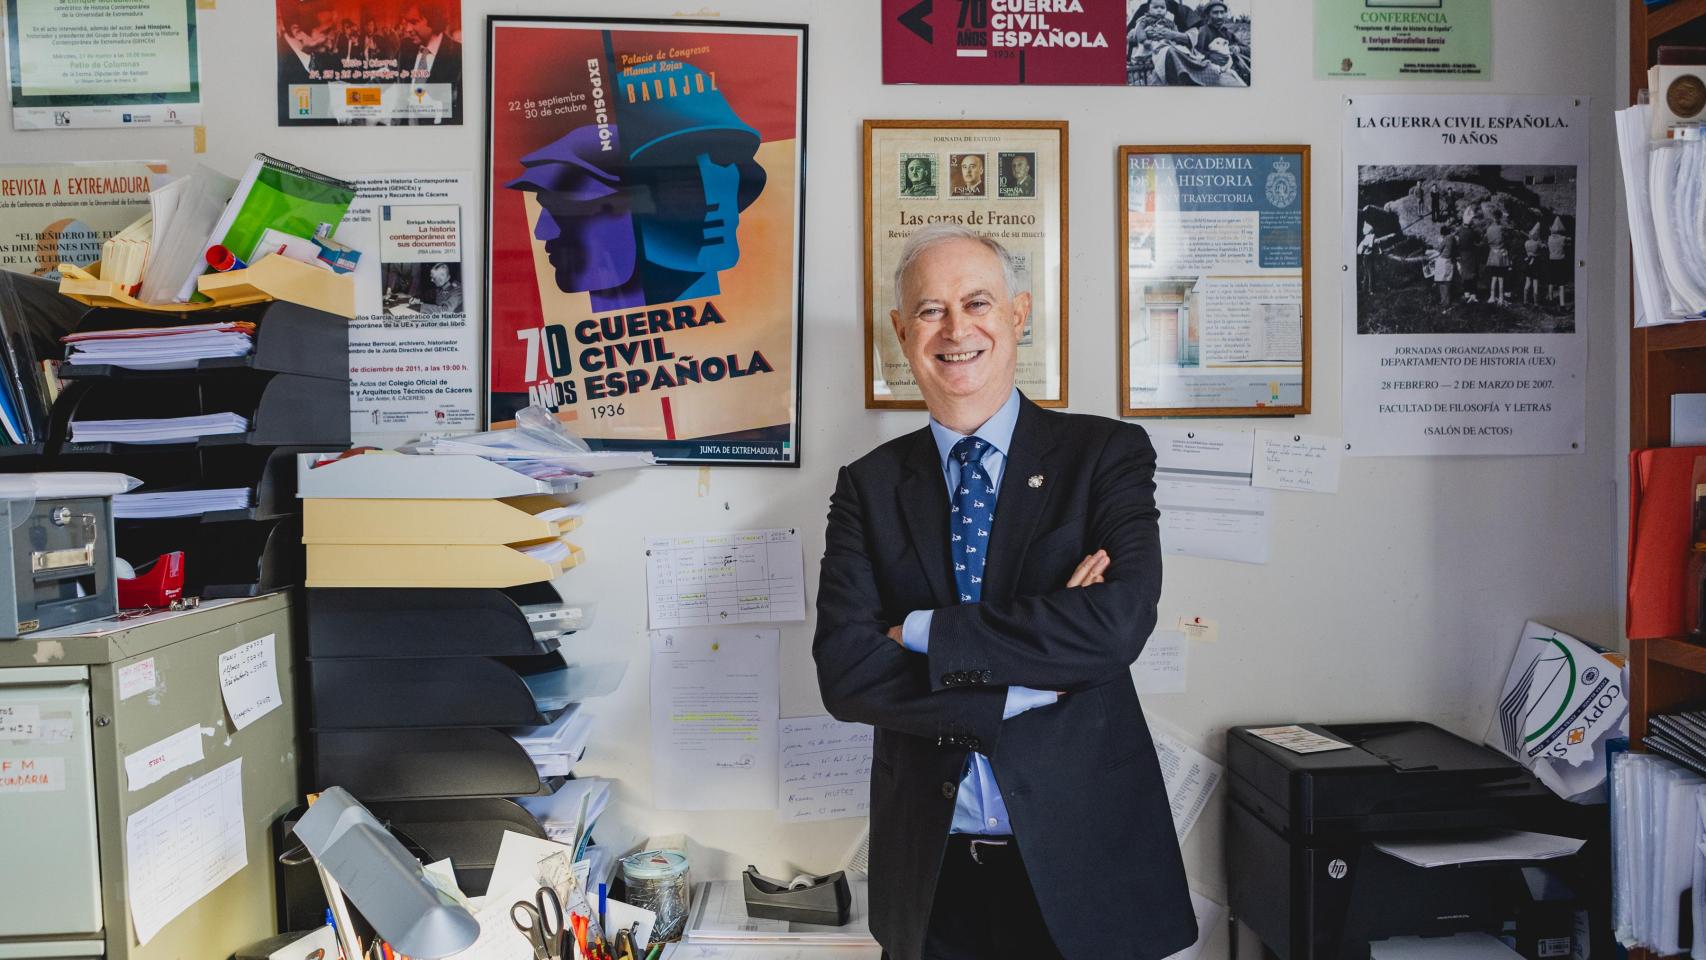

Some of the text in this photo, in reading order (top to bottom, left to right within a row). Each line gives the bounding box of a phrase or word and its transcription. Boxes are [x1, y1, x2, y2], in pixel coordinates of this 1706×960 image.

[992, 0, 1084, 13] GUERRA
[957, 0, 987, 28] 70
[1360, 12, 1448, 23] CONFERENCIA
[992, 14, 1050, 30] CIVIL
[956, 29, 986, 46] AÑOS
[992, 28, 1108, 48] ESPAÑOLA
[621, 45, 710, 65] Palacio de Congresos
[623, 61, 683, 76] Manuel Rojas
[626, 72, 718, 104] BADAJOZ
[508, 92, 586, 111] 22 de septiembre
[587, 58, 612, 152] EXPOSICIÓN
[524, 103, 587, 119] 30 de octubre
[1357, 115, 1568, 128] LA GUERRA CIVIL ESPAÑOLA.
[1442, 131, 1498, 144] 70 AÑOS
[951, 155, 957, 164] 5
[1130, 158, 1253, 169] REAL ACADEMIA
[2, 176, 150, 196] REVISTA A EXTREMADURA
[1179, 175, 1253, 186] HISTORIA
[1183, 194, 1253, 203] TRAYECTORIA
[900, 211, 1035, 225] Las caras de Franco
[35, 231, 85, 240] REÑIDERO
[12, 243, 78, 252] DIMENSIONES
[35, 254, 74, 263] GUERRA
[574, 301, 726, 344] GUERRA
[516, 324, 572, 383] 70
[579, 338, 676, 372] CIVIL
[1395, 347, 1442, 355] JORNADAS
[1381, 358, 1461, 366] DEPARTAMENTO
[1528, 358, 1556, 366] (UEX)
[584, 350, 774, 400] ESPAÑOLA
[1454, 381, 1459, 389] 2
[1462, 381, 1475, 389] DE
[528, 379, 577, 413] AÑOS
[591, 402, 625, 420] 1936
[1379, 402, 1551, 413] FACULTAD DE FILOSOFÍA Y LETRAS
[1424, 425, 1512, 436] (SALÓN DE ACTOS)
[700, 446, 778, 455] JUNTA DE EXTREMADURA
[1584, 685, 1620, 728] COPY
[22, 760, 34, 770] M
[1330, 860, 1344, 878] hp
